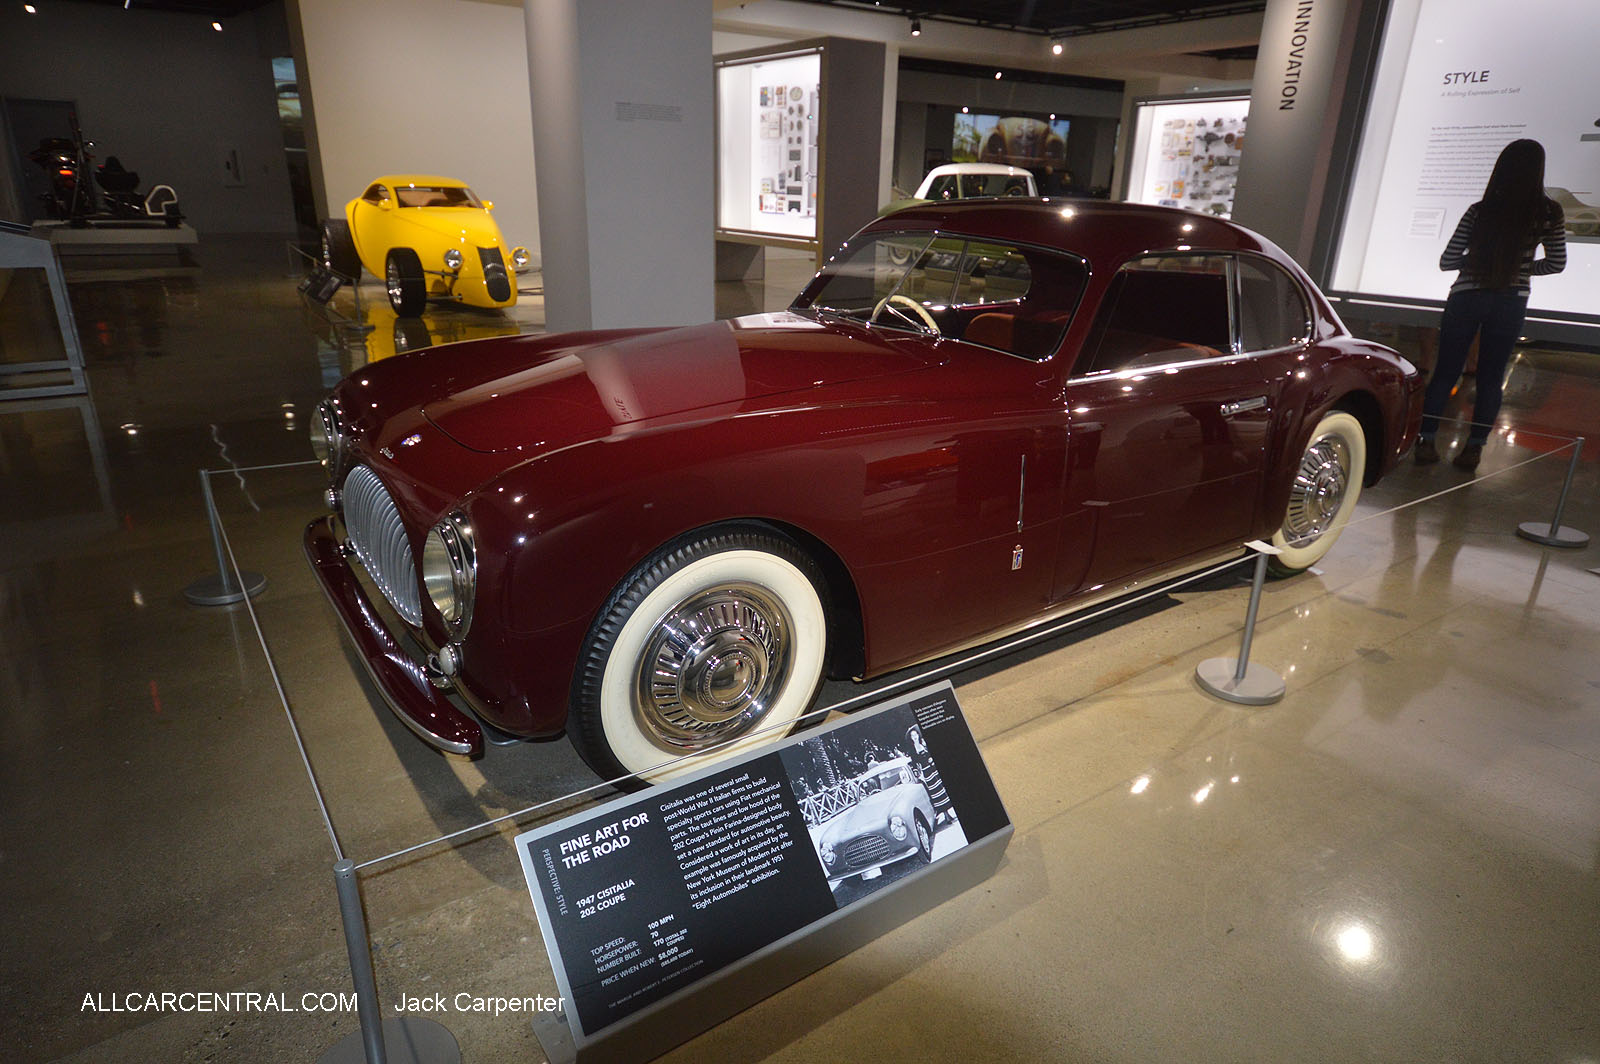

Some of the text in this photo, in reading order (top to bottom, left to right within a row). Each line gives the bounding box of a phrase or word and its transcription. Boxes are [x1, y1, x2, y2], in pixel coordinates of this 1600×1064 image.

[1279, 1, 1314, 110] INNOVATION
[1443, 70, 1490, 84] STYLE
[660, 800, 683, 811] Cisitalia
[715, 779, 734, 791] several
[735, 773, 749, 783] small
[664, 804, 696, 823] post-World
[714, 792, 731, 802] Italian
[731, 787, 746, 795] firms
[752, 777, 766, 787] build
[667, 818, 692, 831] specialty
[693, 810, 712, 821] sports
[725, 799, 740, 808] using
[752, 782, 781, 798] mechanical
[560, 813, 649, 855] FINE ART FOR
[670, 831, 688, 842] parts.
[700, 820, 713, 828] taut
[713, 815, 727, 823] lines
[727, 809, 738, 818] and
[749, 798, 764, 809] hood
[673, 803, 782, 850] 202 Coupe's Pinin Farina-designed body
[692, 845, 705, 854] new
[706, 833, 731, 848] standard
[741, 818, 770, 834] automotive
[770, 811, 791, 821] beauty.
[562, 835, 630, 869] THE ROAD
[680, 851, 714, 870] Considered
[719, 843, 734, 853] work
[734, 839, 740, 847] of
[684, 866, 708, 880] example
[721, 849, 746, 864] famously
[748, 838, 771, 853] acquired
[687, 881, 701, 890] New
[701, 873, 715, 883] York
[716, 864, 740, 877] Museum
[741, 858, 747, 866] of
[748, 851, 770, 863] Modern
[781, 840, 793, 849] after
[542, 848, 568, 916] PERSPECTIVE: STYLE
[576, 879, 635, 908] 1947 CISITALIA
[692, 898, 712, 909] "Eight
[713, 880, 749, 902] Automobiles"
[699, 882, 724, 896] inclusion
[731, 872, 744, 882] their
[745, 860, 771, 876] landmark
[771, 854, 784, 863] 1951
[580, 893, 626, 918] 202 COUPE
[590, 914, 674, 956] TOP SPEED: 100 MPH
[594, 941, 638, 964] HORSEPOWER:
[597, 957, 624, 973] NUMBER
[654, 938, 664, 946] 170
[601, 974, 619, 987] PRICE
[619, 965, 639, 978] WHEN
[658, 947, 678, 960] $8,000
